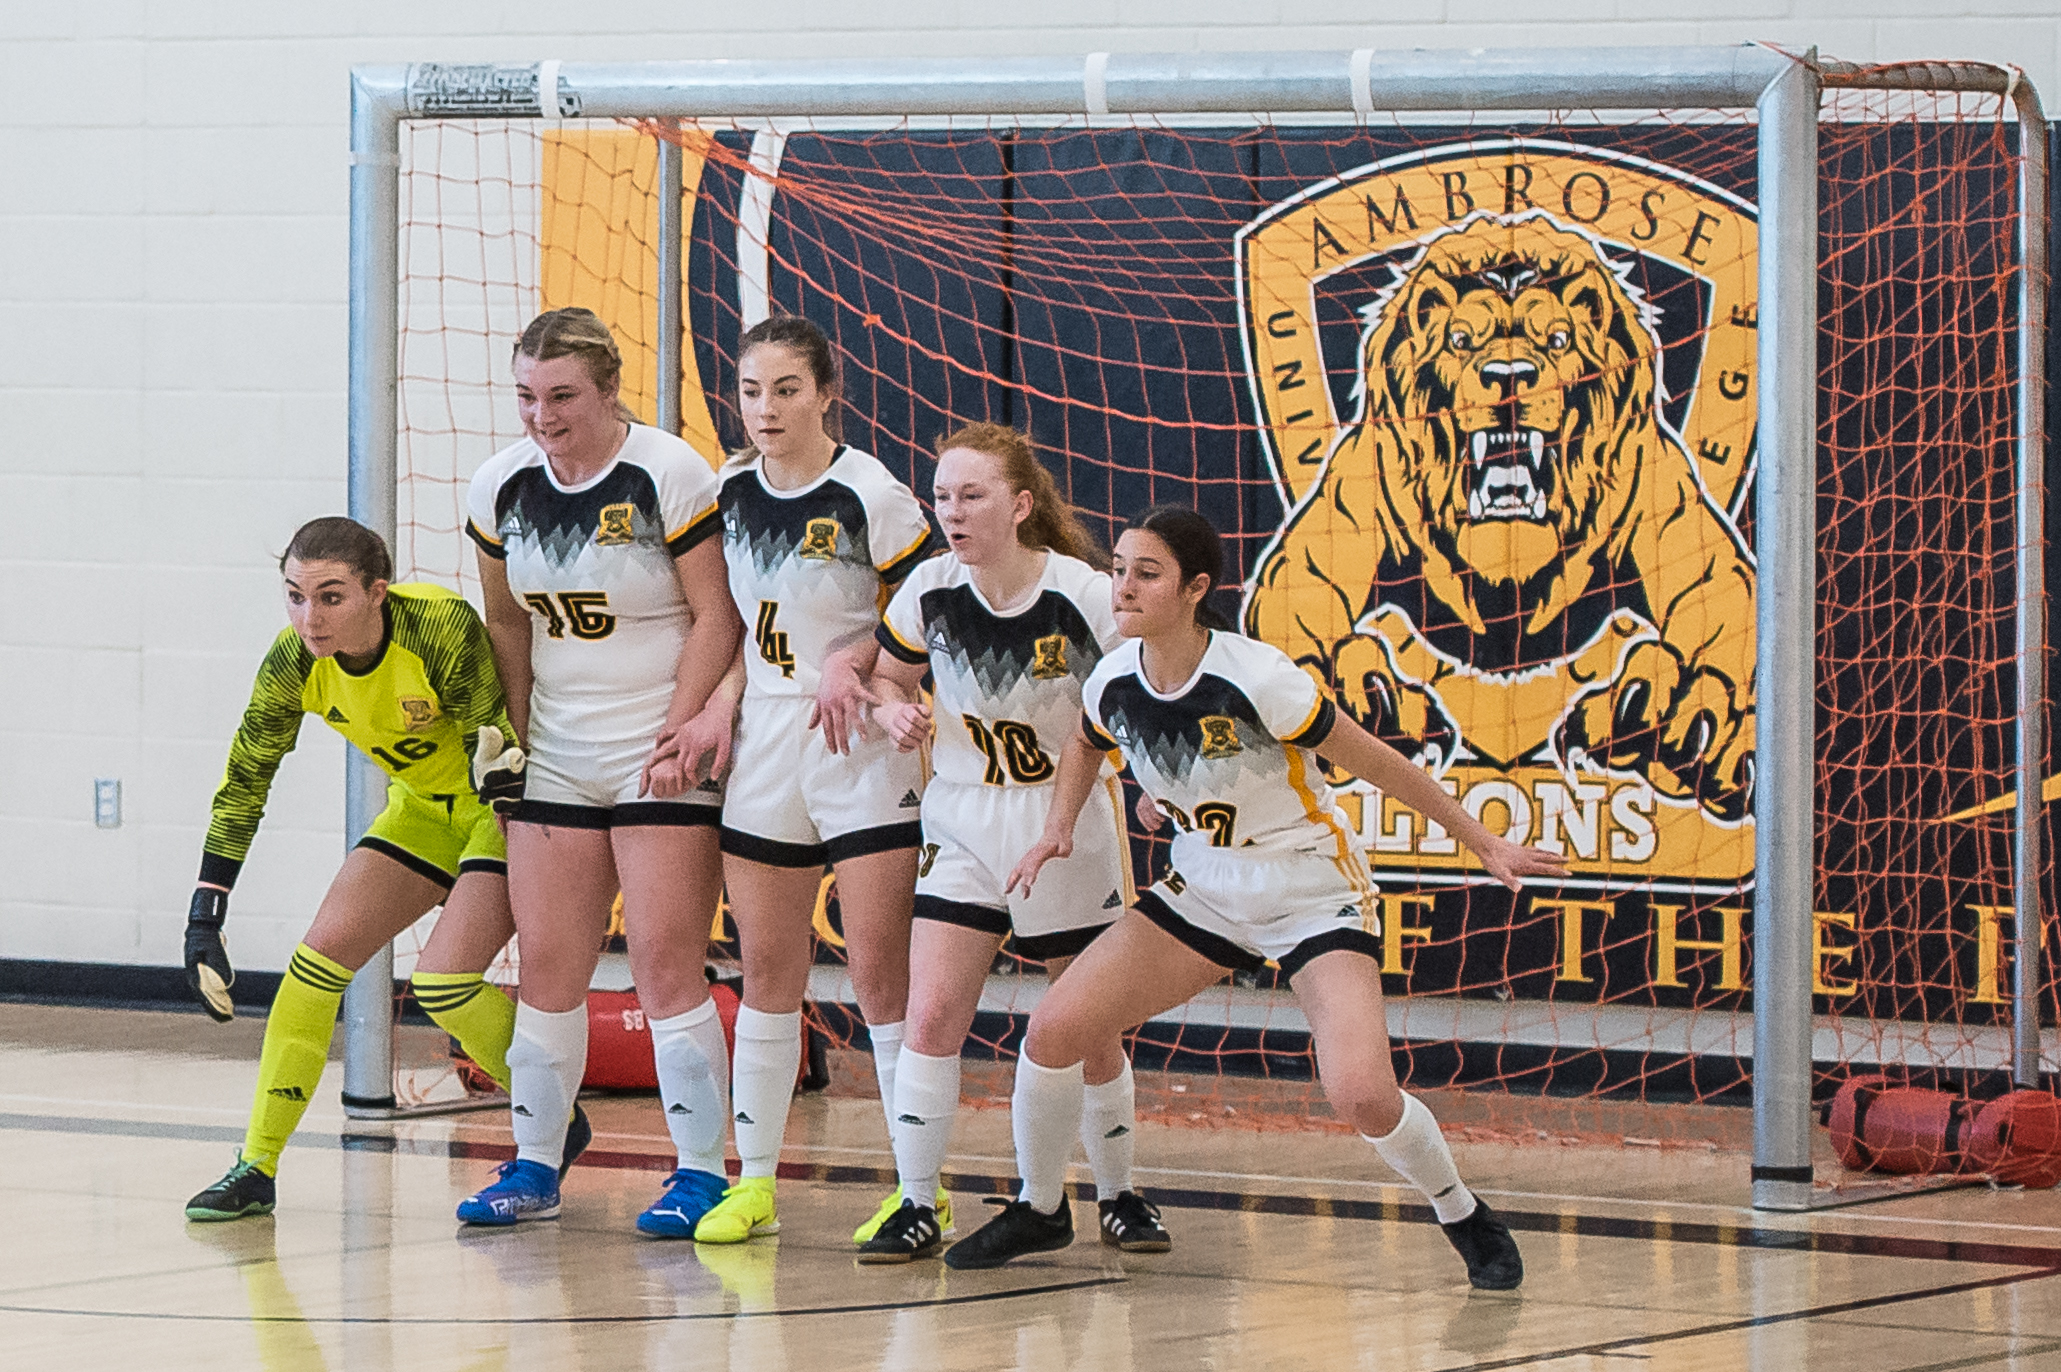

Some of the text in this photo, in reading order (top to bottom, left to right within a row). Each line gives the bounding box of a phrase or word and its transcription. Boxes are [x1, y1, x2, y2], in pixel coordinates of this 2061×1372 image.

[1312, 163, 1722, 269] AMBROSE
[755, 599, 796, 680] 4
[371, 737, 439, 772] 16
[961, 713, 1056, 788] 10
[1530, 896, 1858, 996] THE
